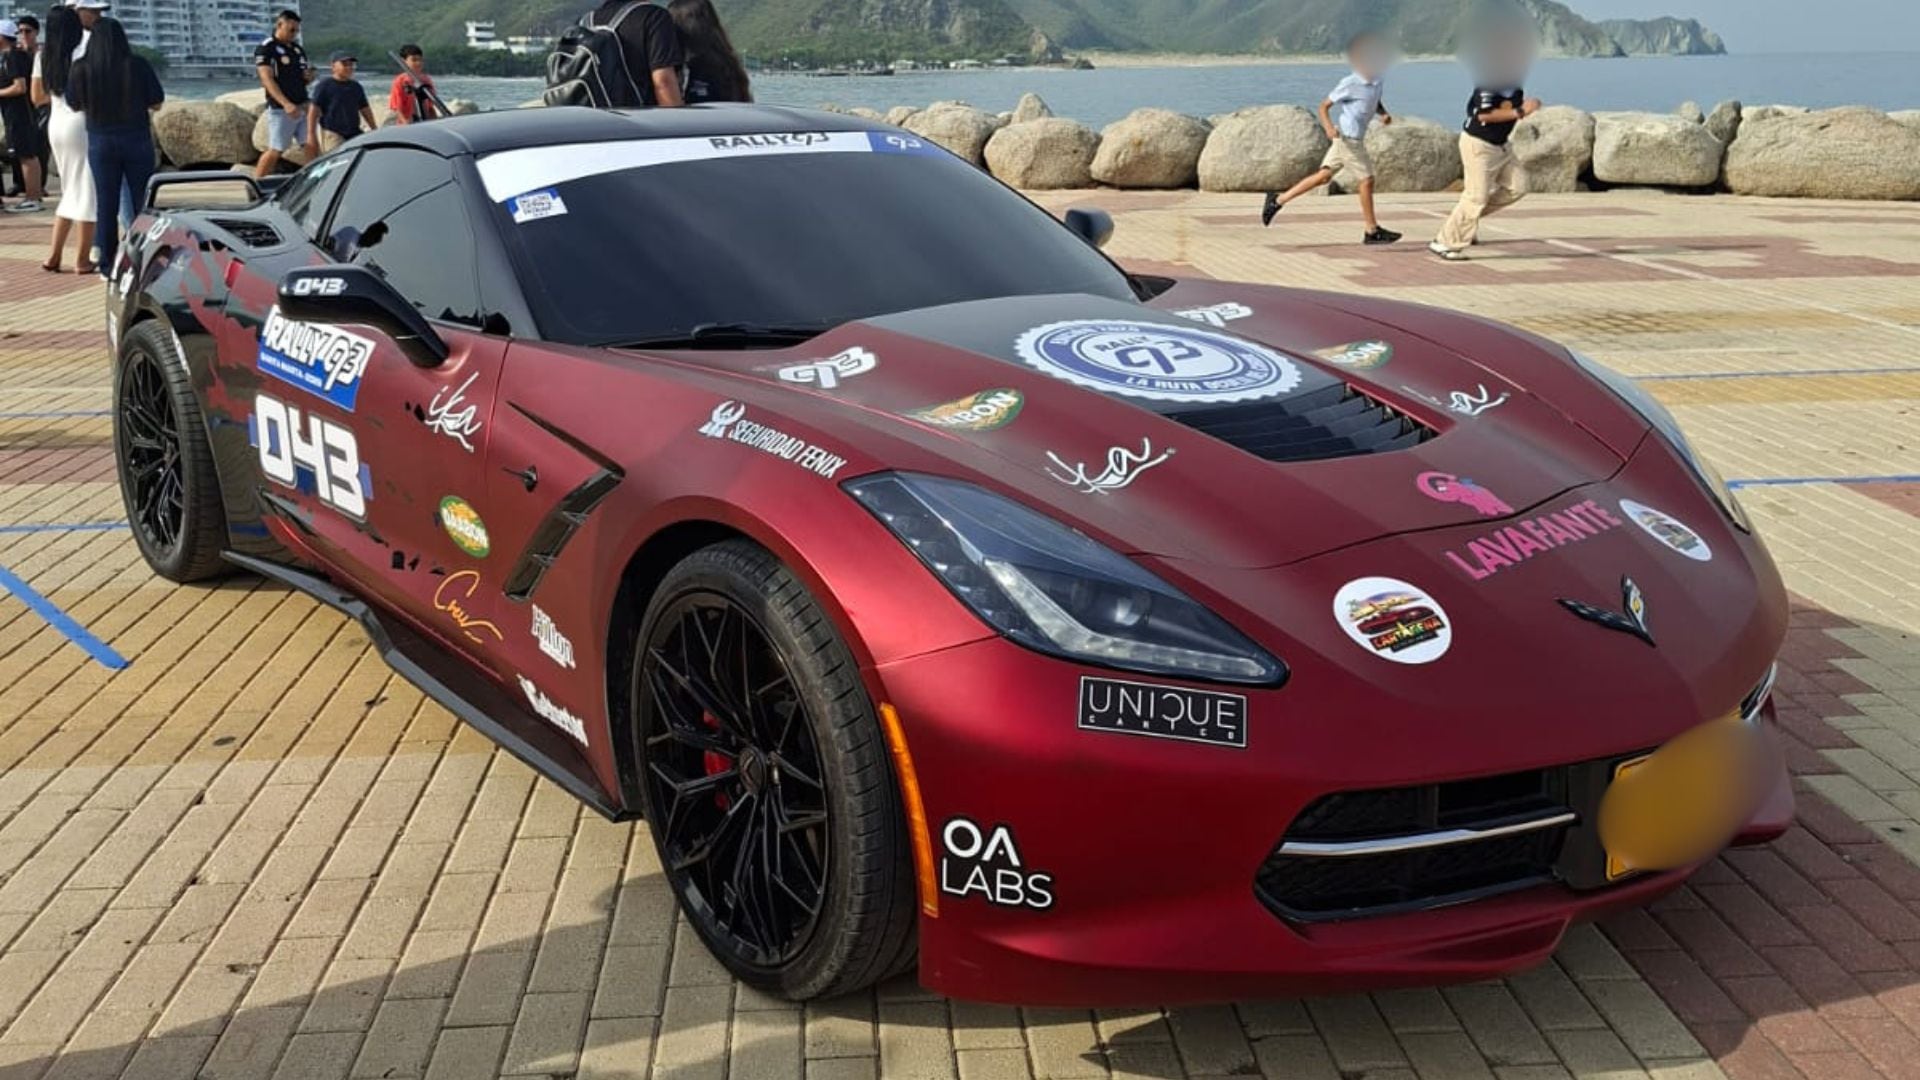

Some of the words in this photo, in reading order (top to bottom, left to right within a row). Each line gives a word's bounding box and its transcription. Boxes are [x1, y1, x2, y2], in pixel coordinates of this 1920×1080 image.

[294, 278, 345, 296] 043
[1114, 338, 1203, 375] 93
[255, 394, 367, 518] 043
[727, 419, 806, 461] SEGURIDAD
[794, 445, 848, 479] FENIX
[1446, 499, 1623, 581] LAVAFANTE
[1088, 683, 1238, 731] UNIQUE
[943, 818, 1021, 867] OA
[942, 856, 1053, 908] LABS
